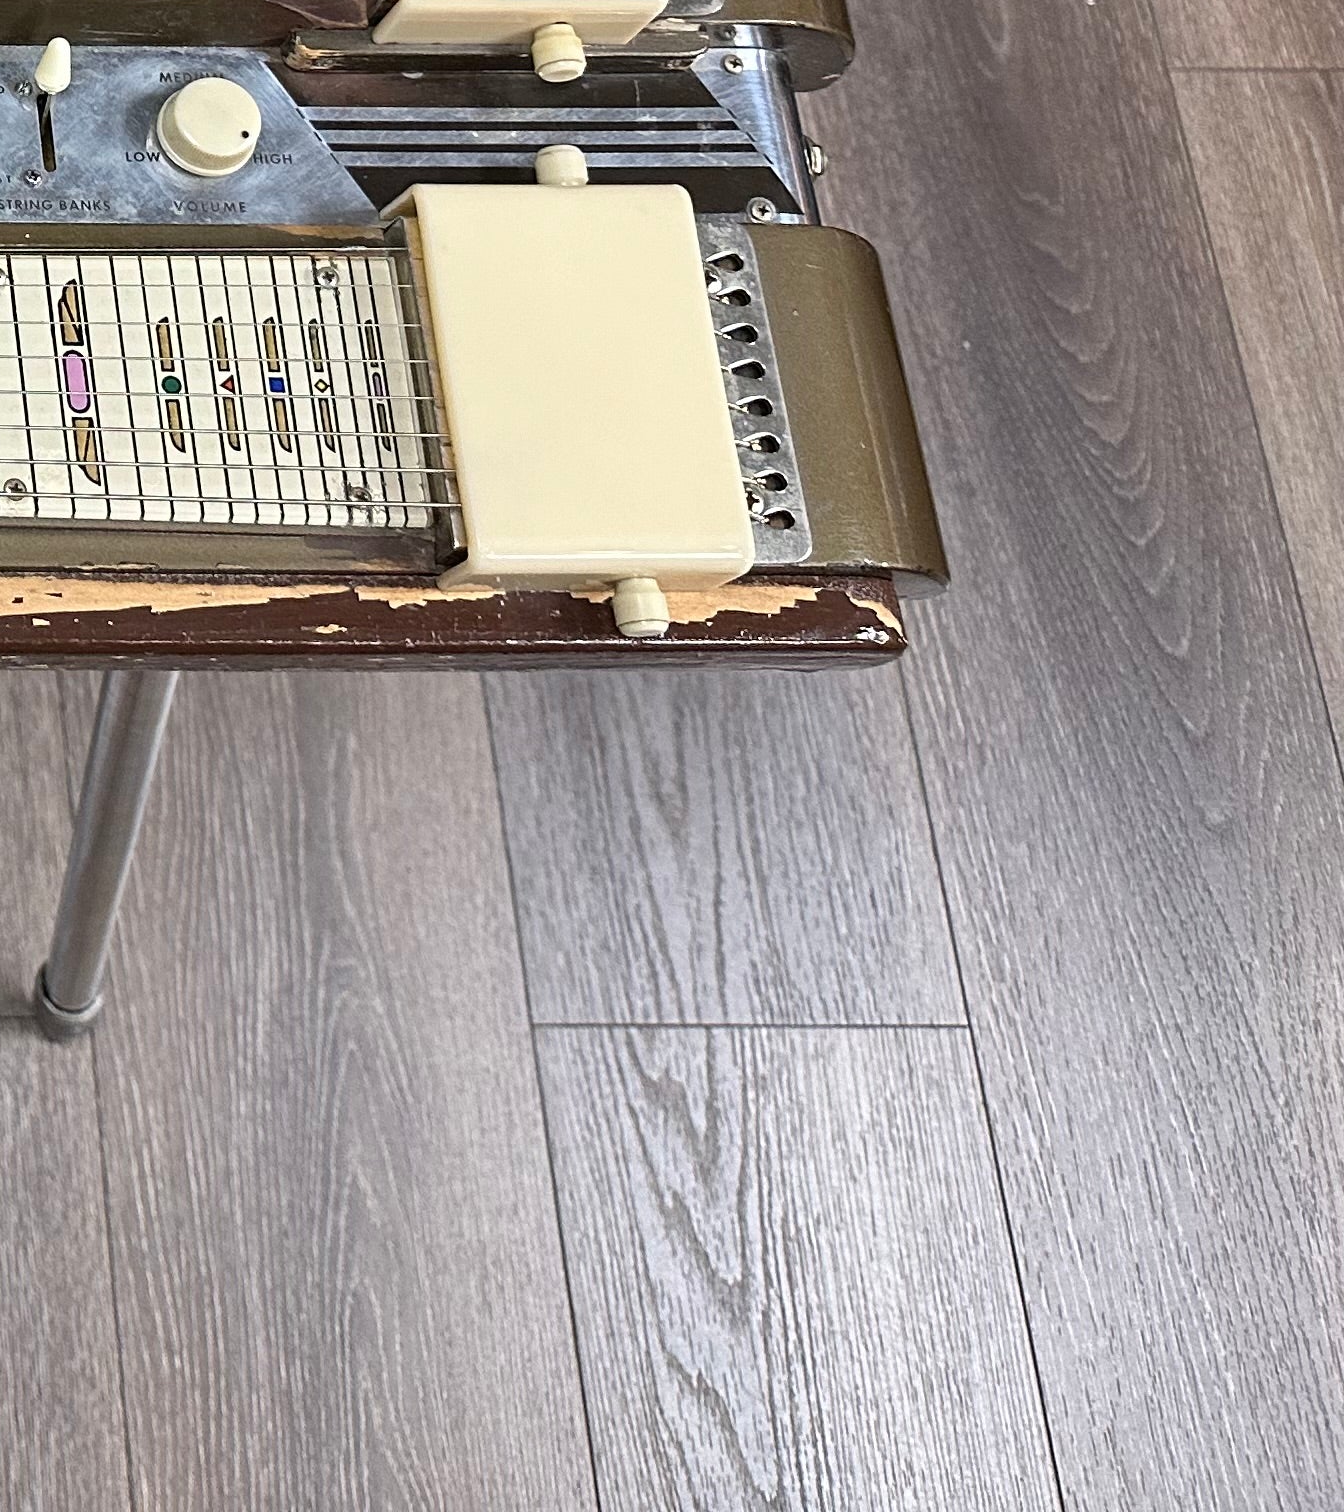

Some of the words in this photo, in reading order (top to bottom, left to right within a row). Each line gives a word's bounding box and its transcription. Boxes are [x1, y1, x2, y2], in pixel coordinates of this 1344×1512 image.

[125, 151, 161, 163] LOW
[252, 152, 294, 166] HIGH
[59, 199, 112, 213] BANKS
[173, 200, 248, 214] VOLUME
